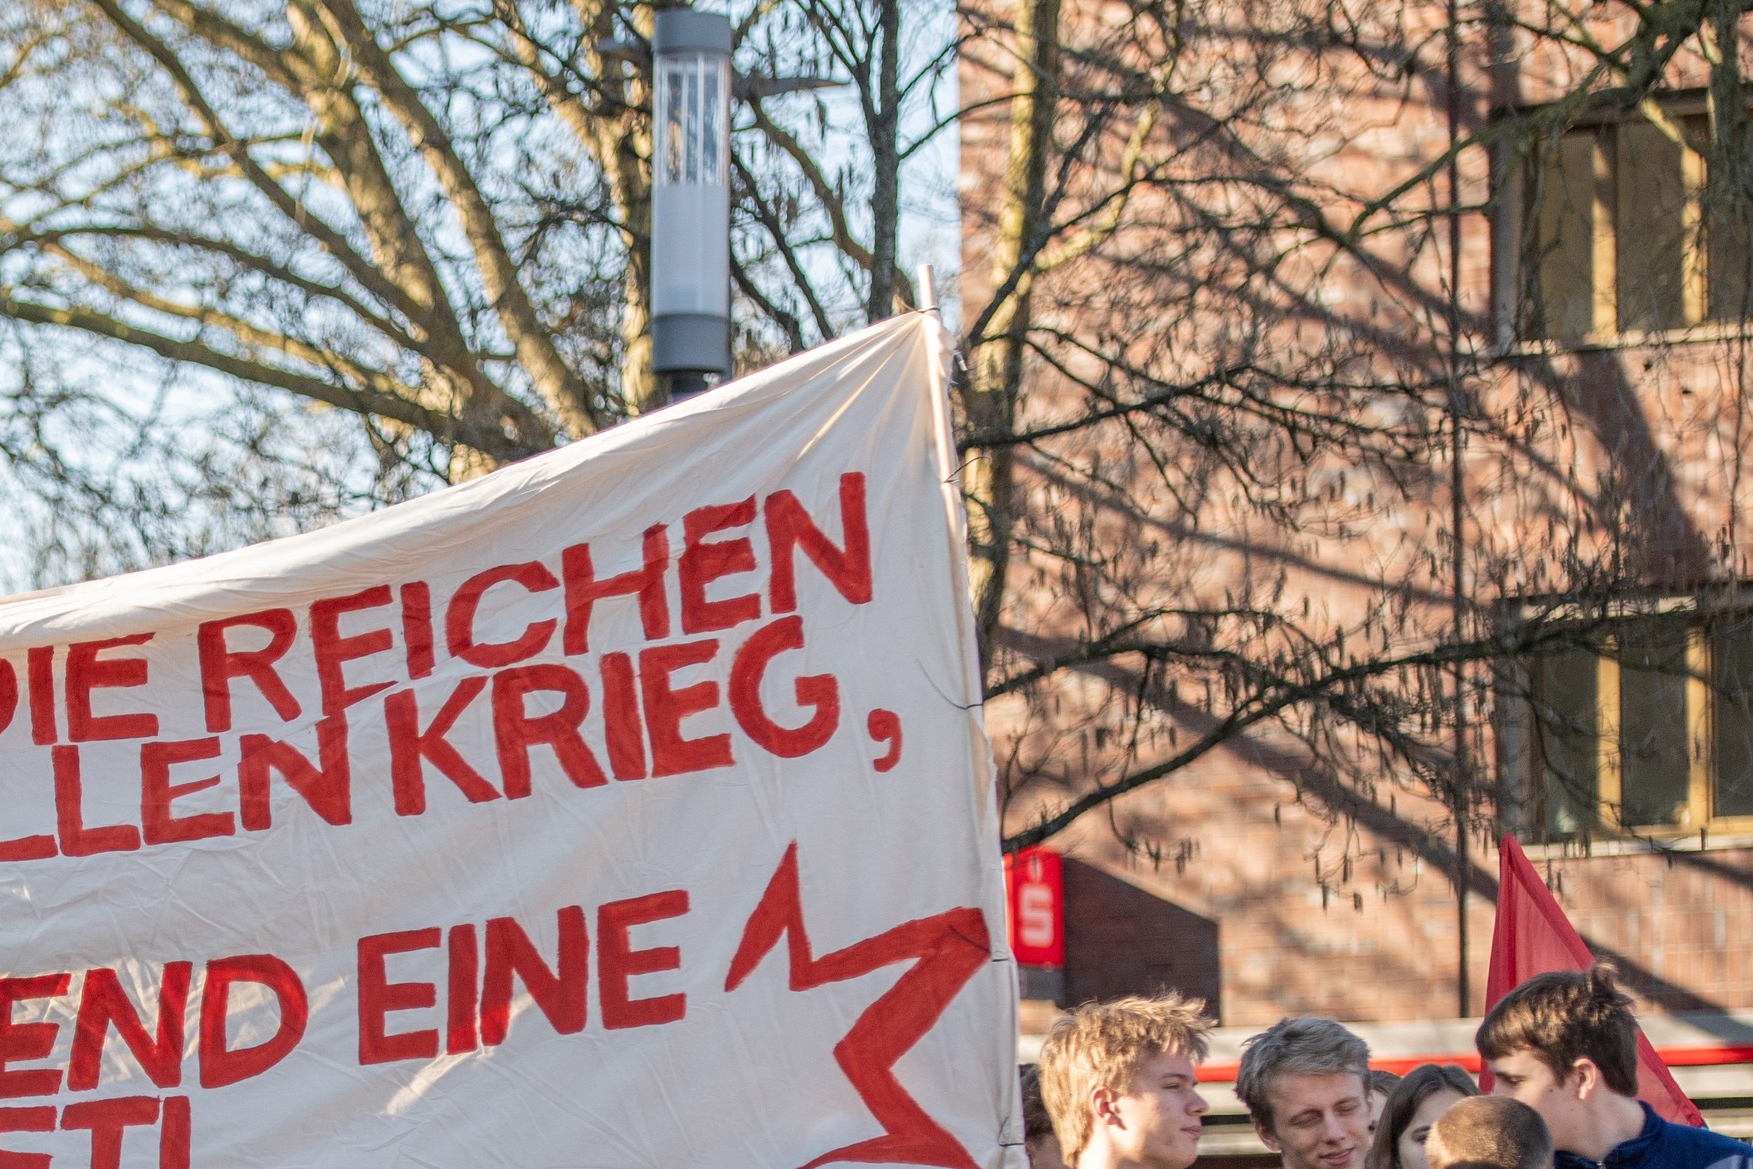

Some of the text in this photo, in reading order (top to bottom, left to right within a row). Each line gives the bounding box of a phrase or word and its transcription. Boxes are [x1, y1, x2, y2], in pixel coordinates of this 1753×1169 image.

[197, 471, 872, 733] REICHEN
[384, 615, 902, 816] KRIEG,
[357, 890, 689, 1065] EINE
